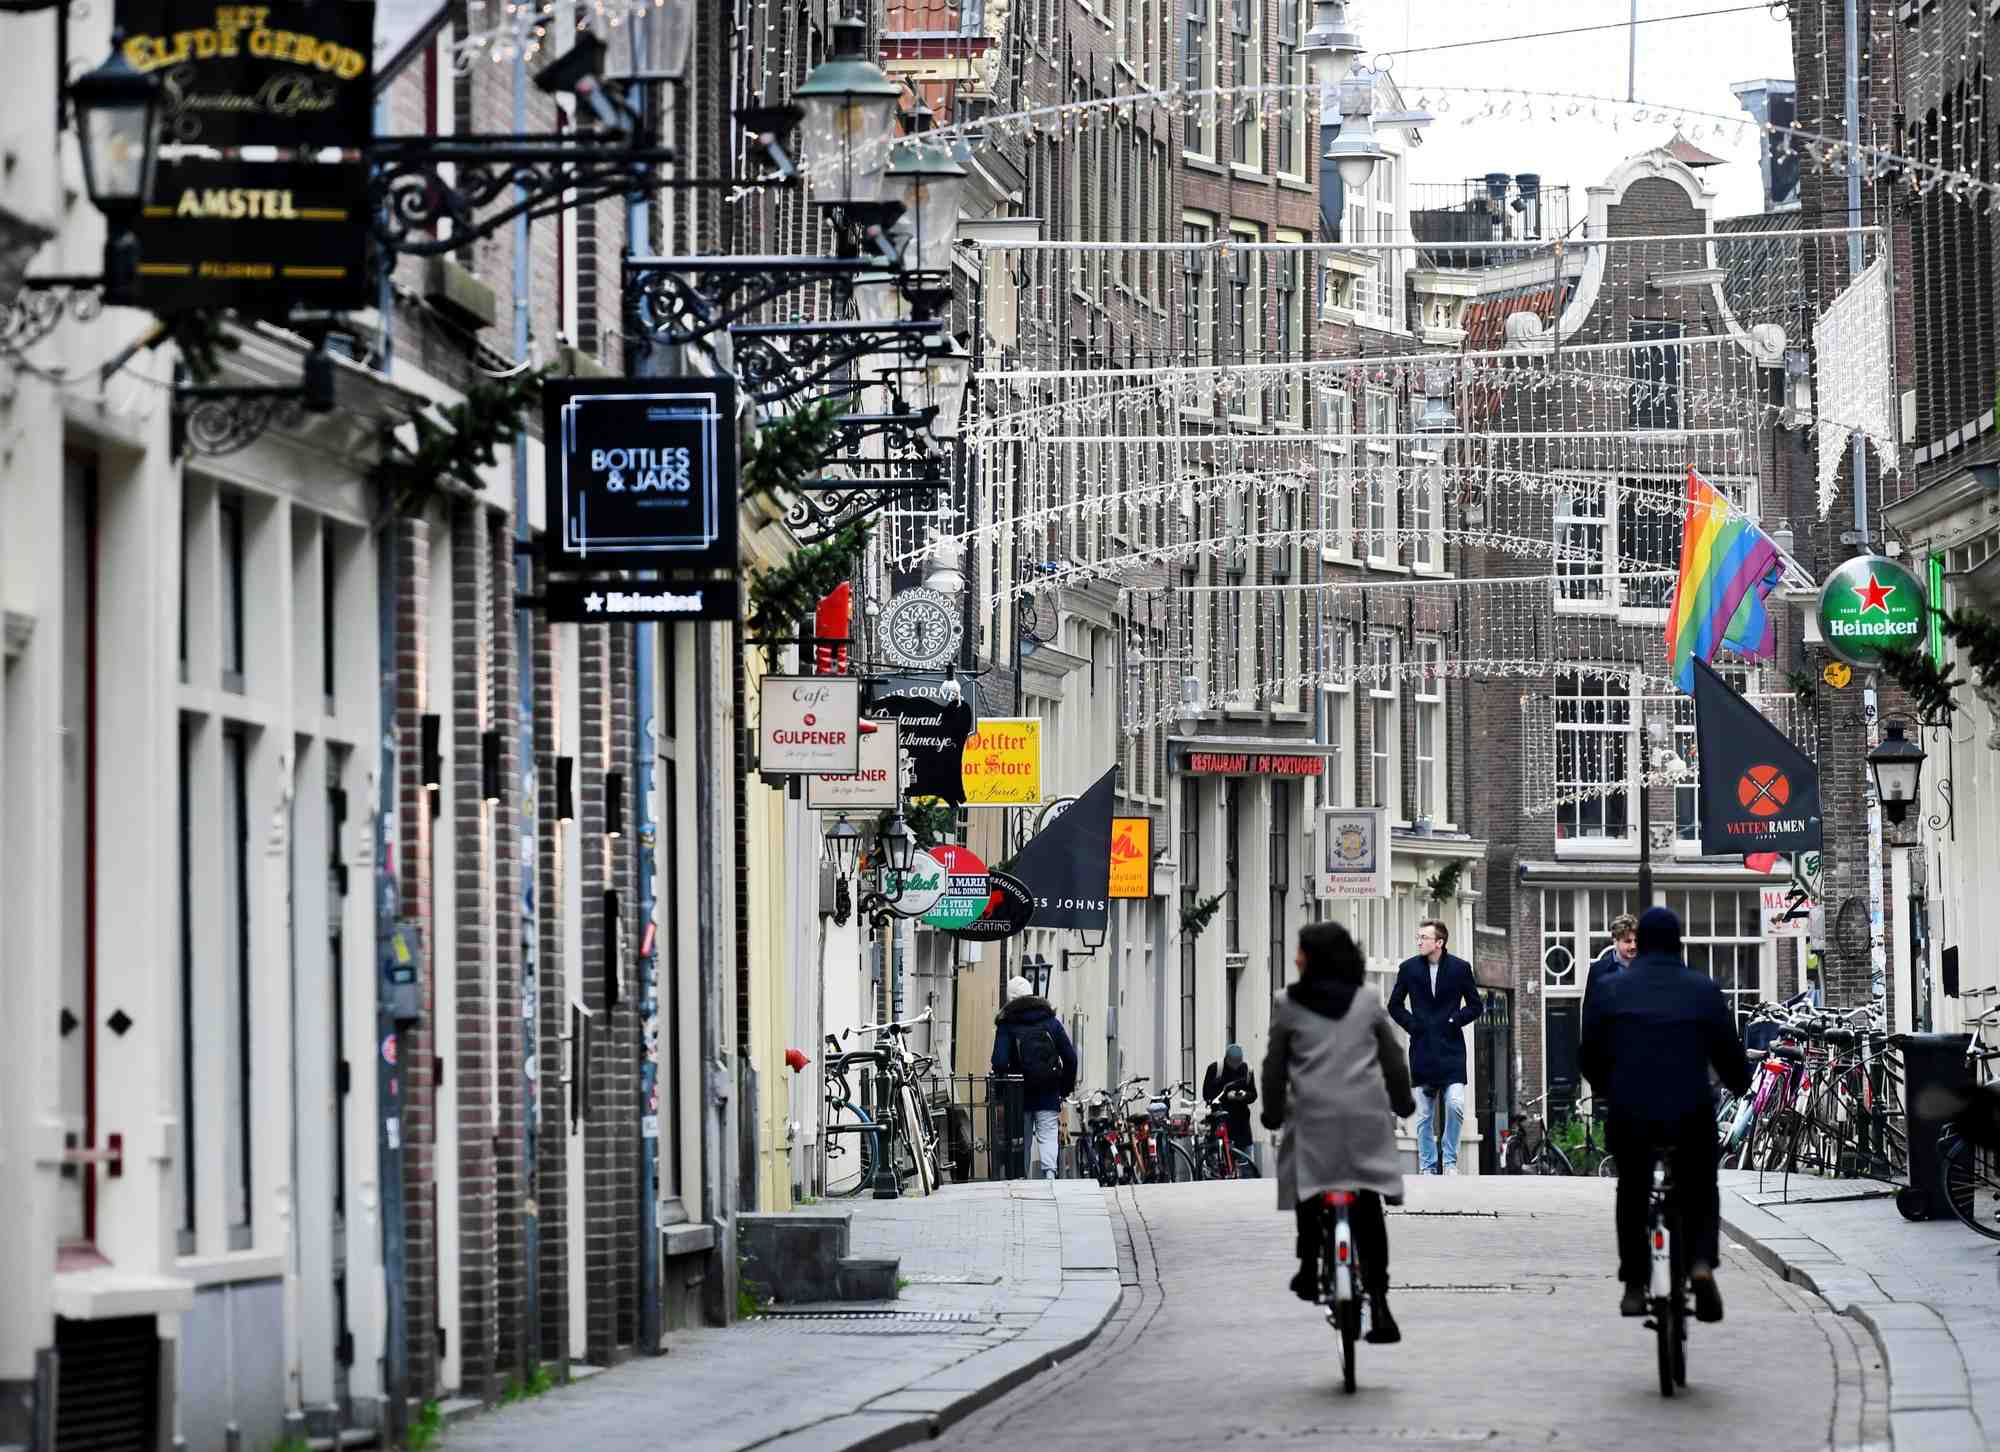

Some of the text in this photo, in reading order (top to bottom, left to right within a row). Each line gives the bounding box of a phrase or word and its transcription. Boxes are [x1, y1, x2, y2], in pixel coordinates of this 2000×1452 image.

[123, 29, 366, 79] ELFDE GEBOD
[177, 188, 300, 219] AMSTEL
[591, 447, 690, 471] BOTTLES
[606, 467, 690, 492] & JARS
[1830, 618, 1917, 637] Heineken
[792, 685, 831, 709] Café
[772, 729, 846, 745] GULPENER
[984, 754, 1032, 776] Store
[1192, 753, 1248, 772] RESTAURANT
[956, 877, 987, 887] MARIA
[962, 887, 987, 896] DINNER
[988, 876, 1029, 904] estaurant
[1056, 898, 1105, 911] JOHNS
